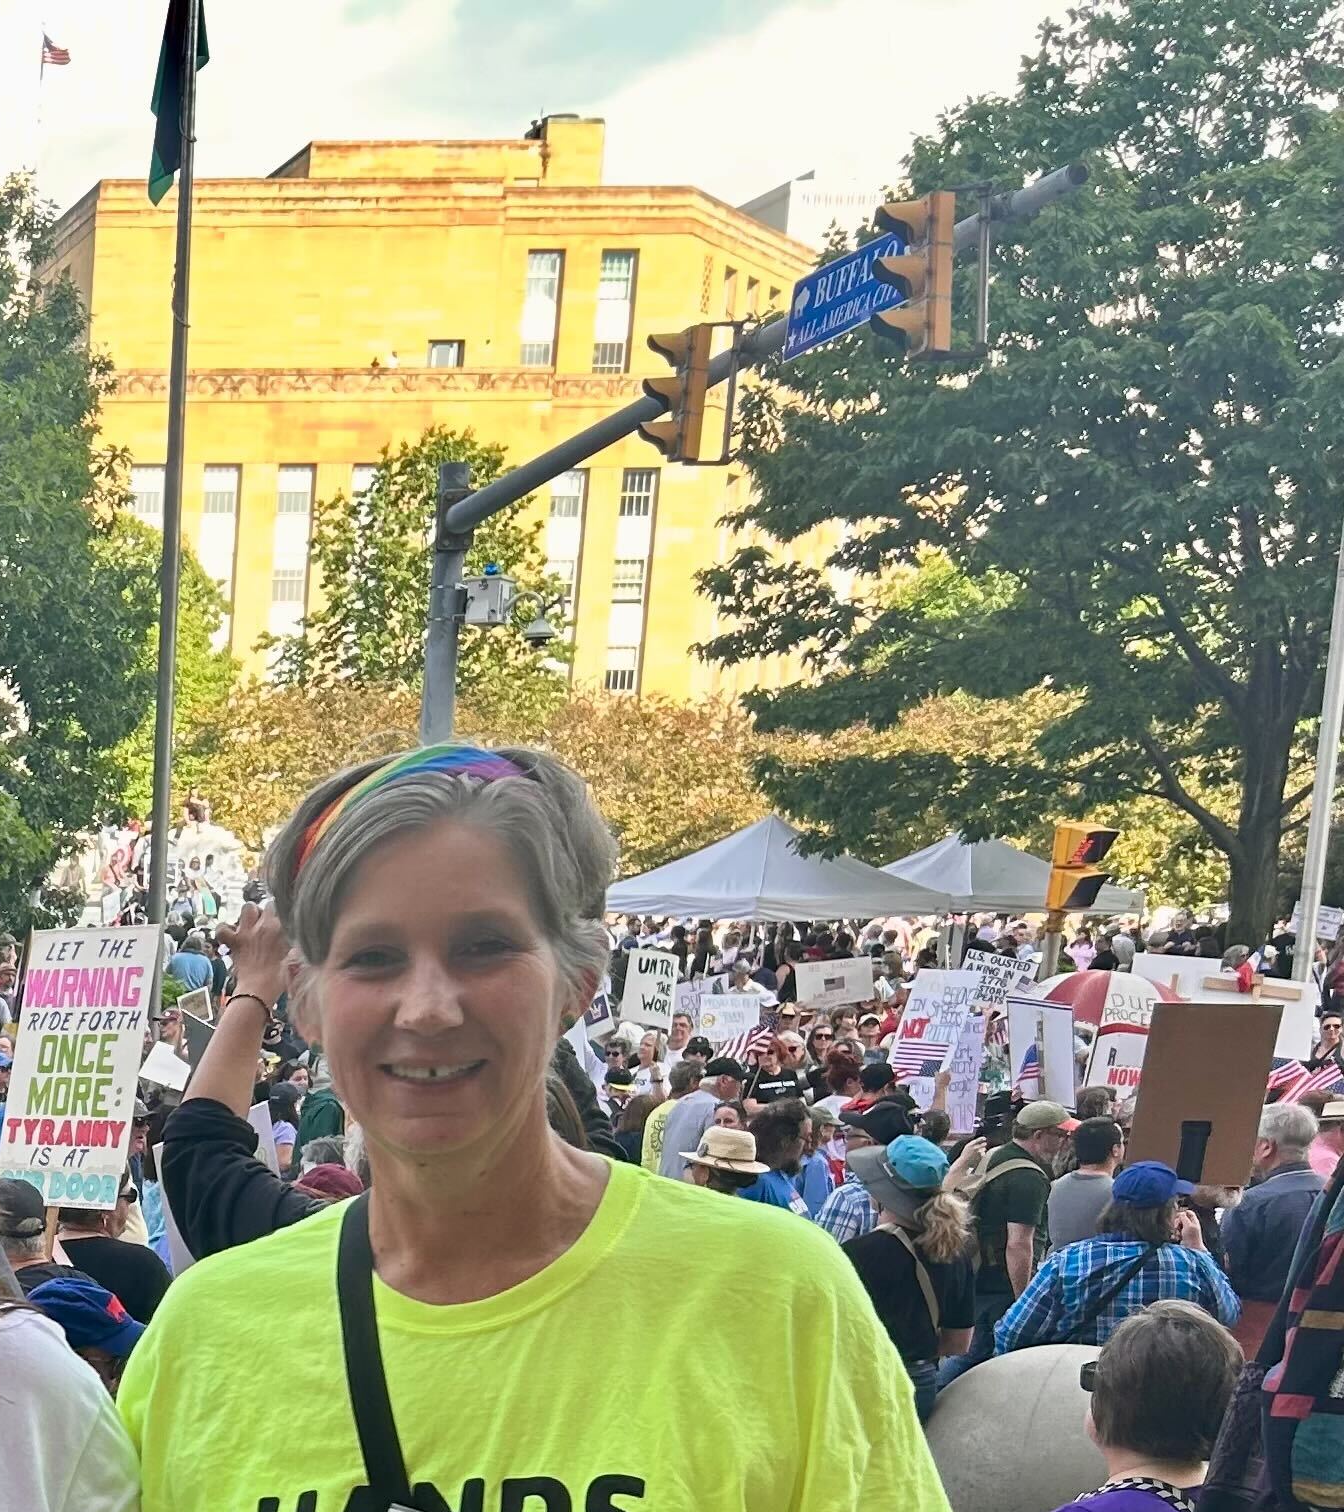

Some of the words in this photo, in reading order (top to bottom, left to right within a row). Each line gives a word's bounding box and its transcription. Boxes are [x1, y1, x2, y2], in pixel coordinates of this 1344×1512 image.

[45, 940, 85, 962] LET
[95, 938, 138, 959] THE
[976, 963, 1001, 977] KING
[990, 956, 1032, 973] OUSTED
[24, 965, 145, 1009] WARNING
[975, 990, 1005, 1005] PEATS
[979, 984, 1010, 997] STORY
[1110, 993, 1157, 1012] DUE
[27, 1012, 75, 1032] RIDE
[75, 1010, 142, 1031] FORTH
[1104, 1007, 1149, 1026] PROCE
[899, 1017, 932, 1041] NOT
[36, 1033, 119, 1074] ONCE
[25, 1077, 122, 1118] MORE:
[6, 1117, 127, 1149] TYRANNY
[29, 1146, 52, 1167] IS
[62, 1148, 90, 1168] AT
[48, 1171, 117, 1204] DOOR
